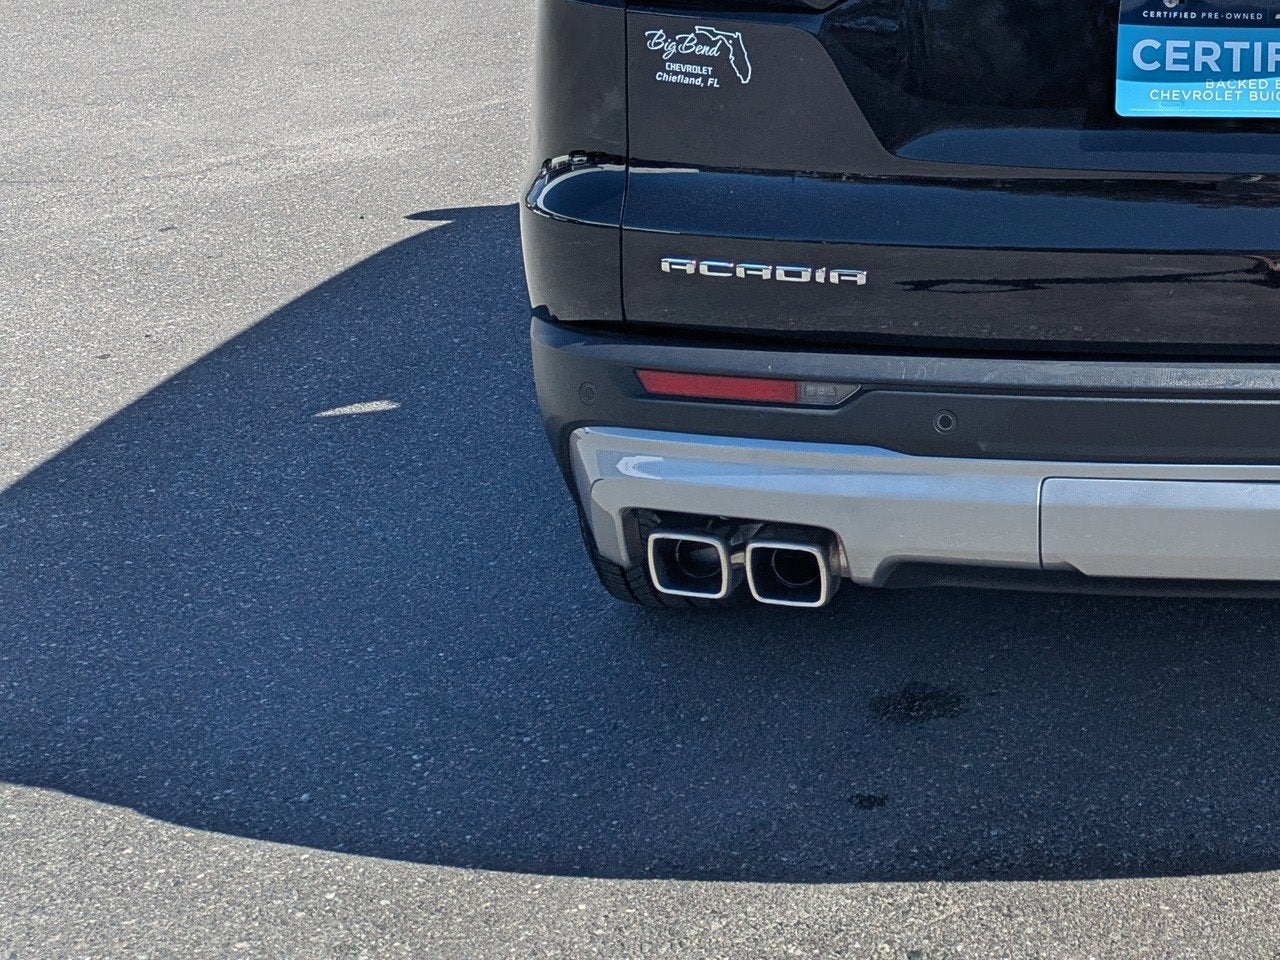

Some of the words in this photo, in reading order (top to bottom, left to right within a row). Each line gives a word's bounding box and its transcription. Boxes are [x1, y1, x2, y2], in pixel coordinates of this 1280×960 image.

[1142, 10, 1197, 19] CERTIFIED
[644, 29, 677, 60] Big
[675, 32, 723, 57] Bend
[666, 62, 713, 76] CHEVROLET
[655, 71, 704, 88] Chiefland,
[707, 78, 720, 88] FL
[1205, 78, 1270, 90] BACKED
[1149, 89, 1242, 101] CHEVROLET
[661, 257, 867, 286] ACADIA
